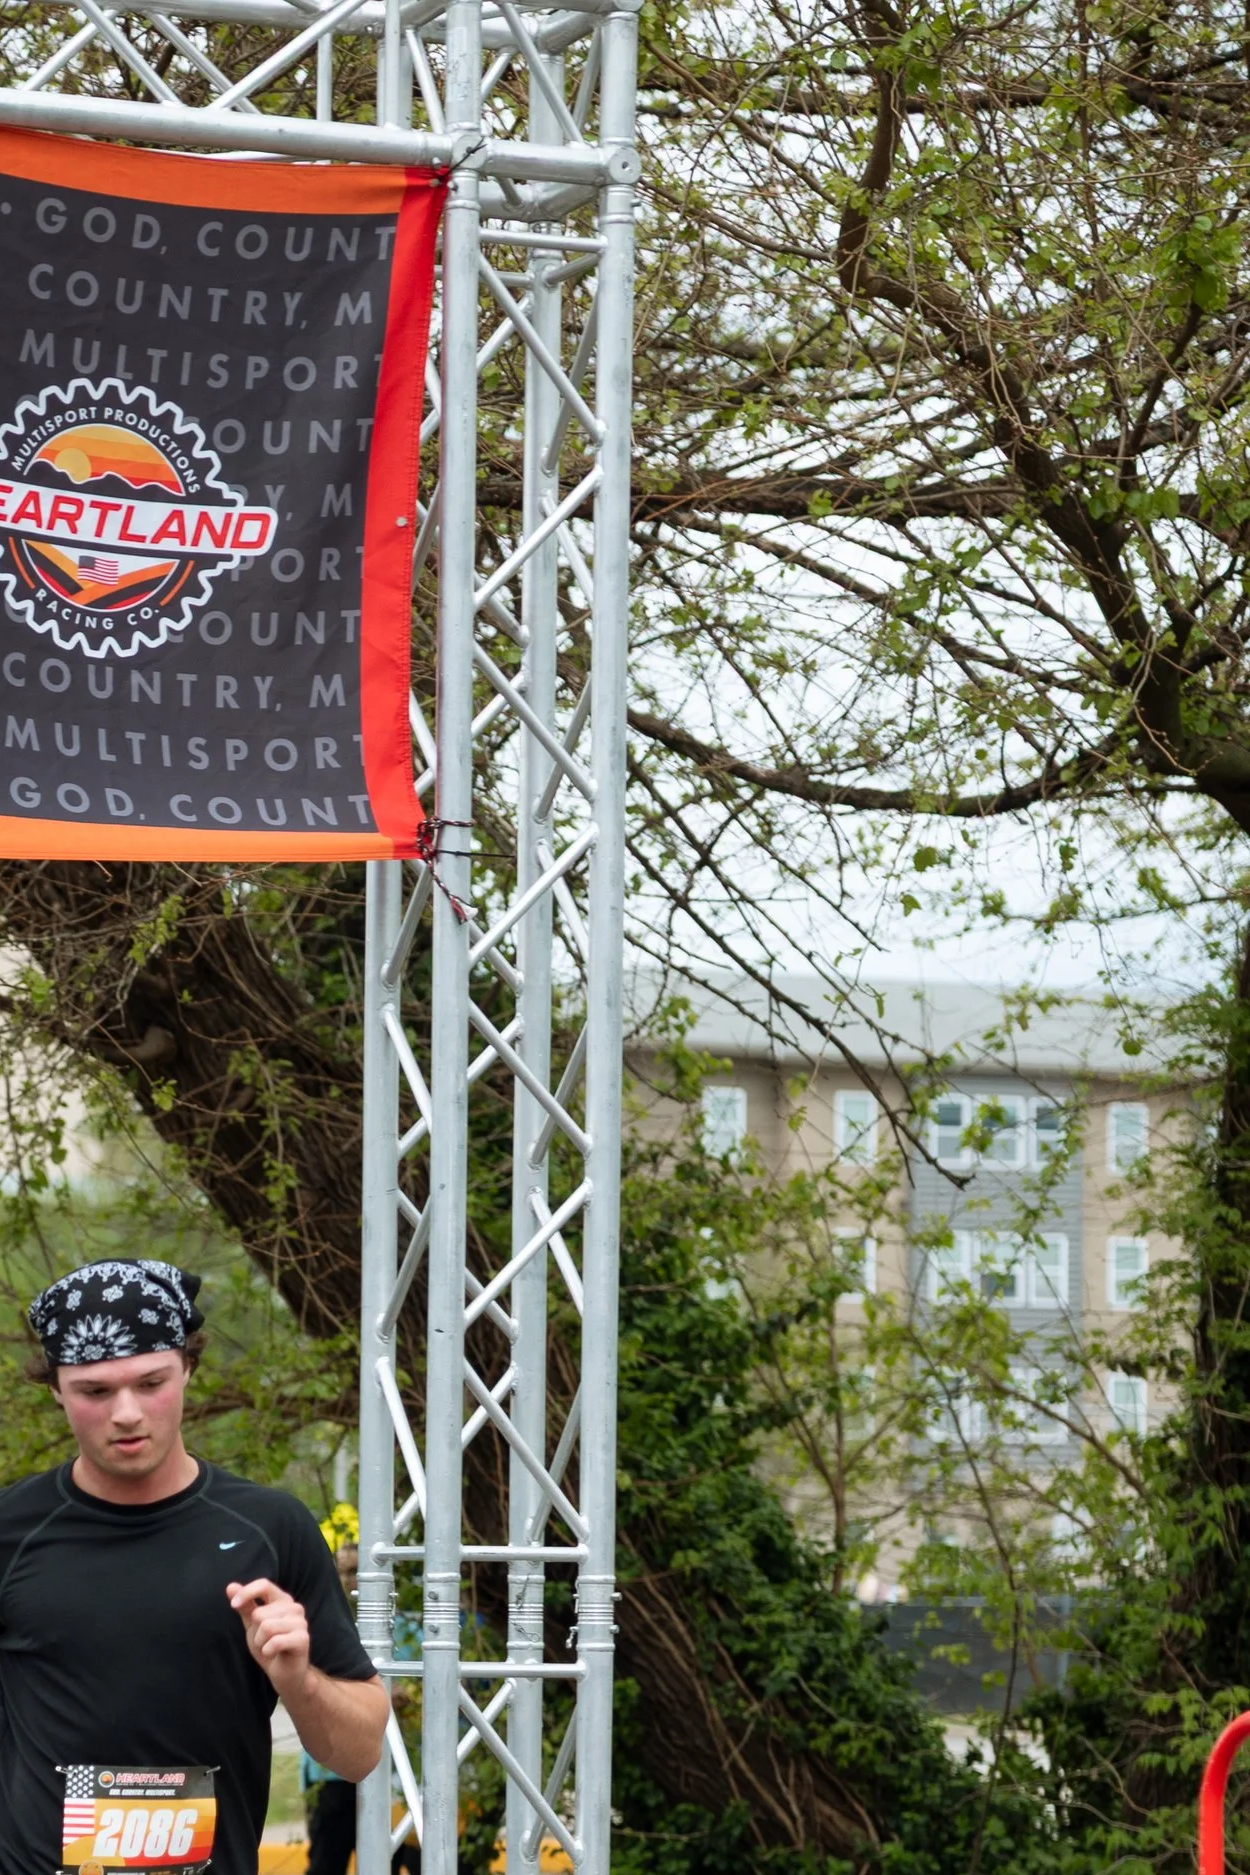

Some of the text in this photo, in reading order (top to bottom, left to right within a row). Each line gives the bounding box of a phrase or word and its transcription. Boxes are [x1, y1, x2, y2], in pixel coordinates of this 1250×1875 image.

[35, 197, 168, 256] GOD,
[196, 221, 396, 263] COUNT
[27, 262, 308, 331] COUNTRY,
[11, 406, 200, 494] MULTISPORT PRODUCTIONS
[183, 416, 375, 456] OUNT
[34, 587, 114, 631] RACING
[167, 608, 361, 647] OUNT
[2, 651, 282, 712] COUNTRY,
[168, 793, 370, 827] COUNT
[92, 1808, 198, 1858] 2086
